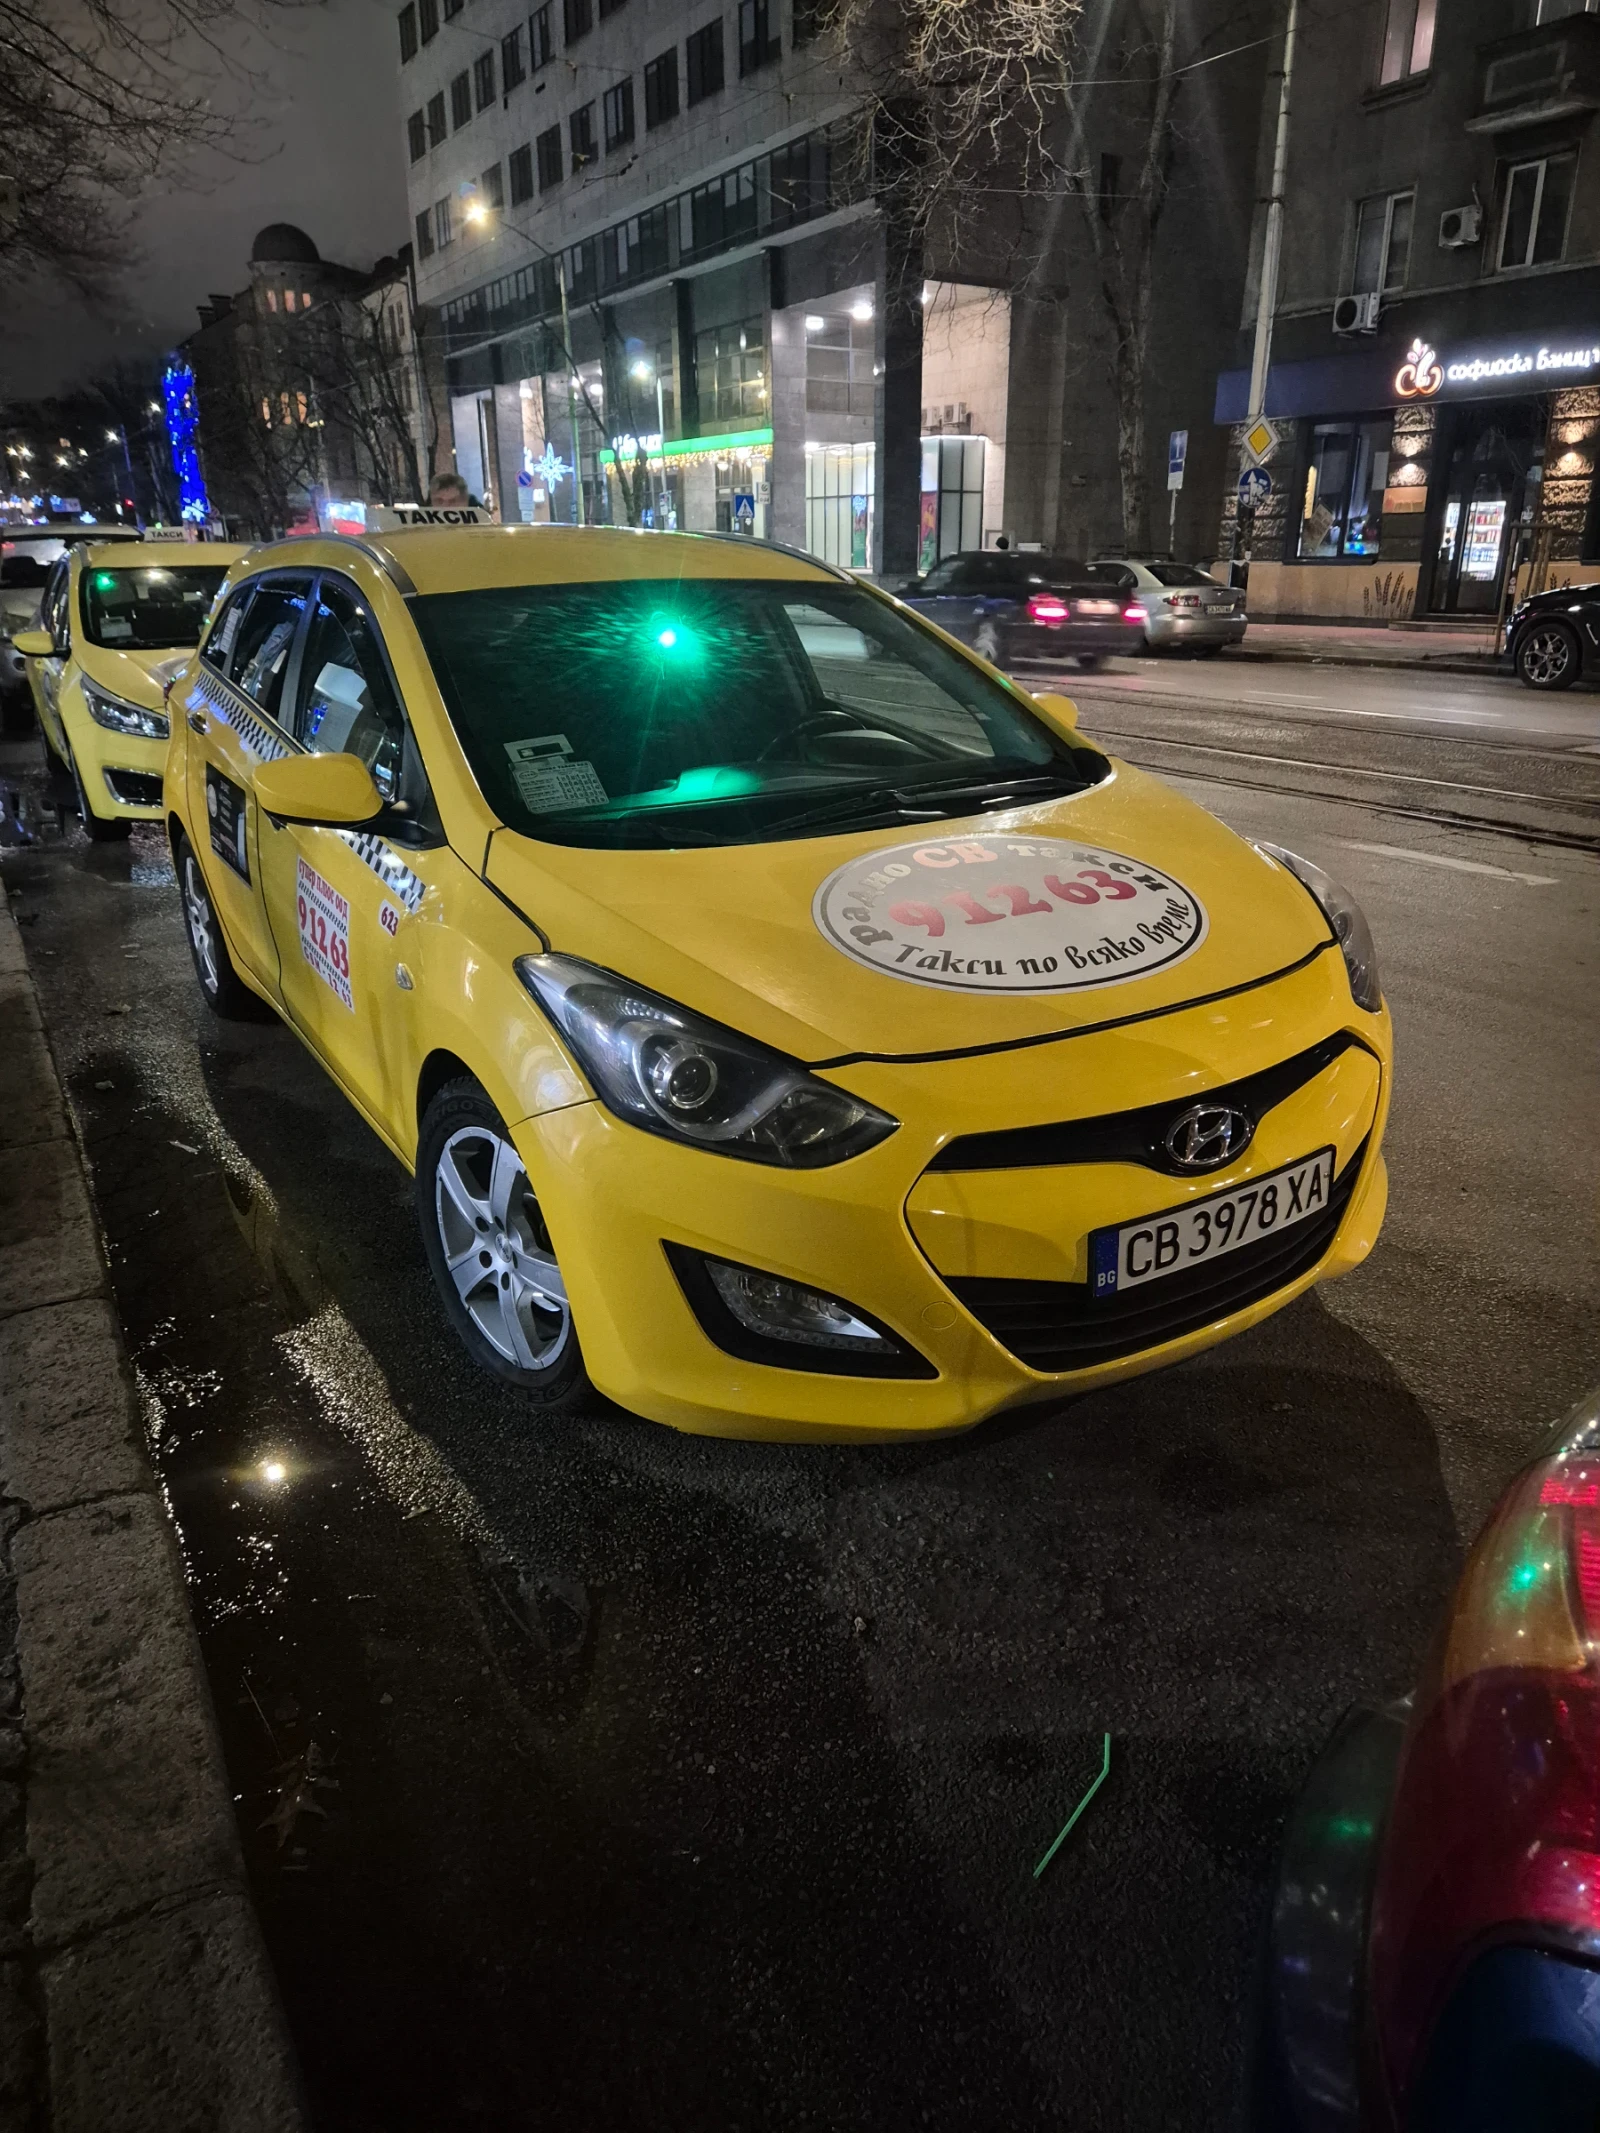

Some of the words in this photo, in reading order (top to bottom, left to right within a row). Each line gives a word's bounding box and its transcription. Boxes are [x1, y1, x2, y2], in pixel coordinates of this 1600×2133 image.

[393, 509, 479, 525] ТАКСИ
[151, 530, 184, 539] ТАКСИ
[381, 906, 399, 936] 623
[894, 943, 1007, 976] Такси
[1016, 956, 1058, 975] по
[1064, 937, 1146, 969] всяко
[1136, 897, 1192, 944] време
[1126, 1220, 1181, 1278] CB
[1188, 1184, 1278, 1257] 3978
[1285, 1163, 1323, 1221] XA
[1097, 1269, 1116, 1288] BG
